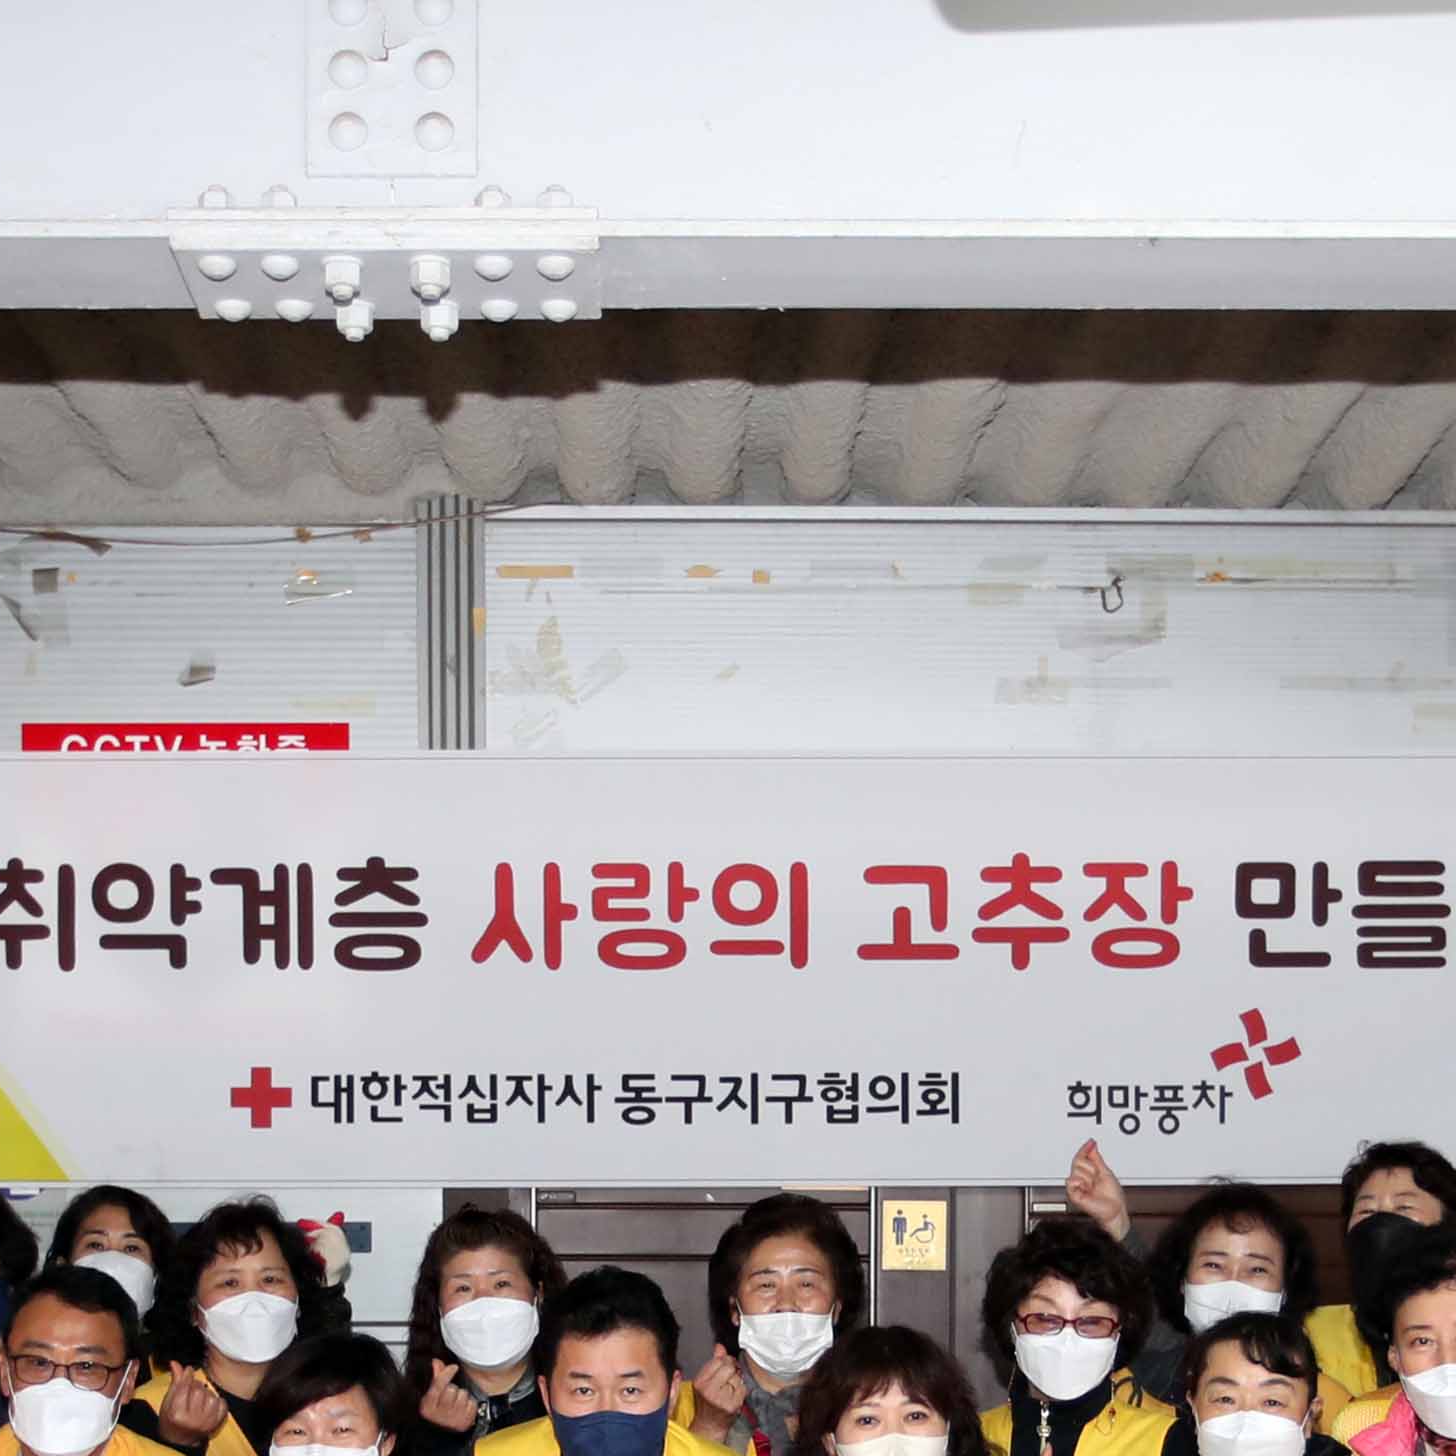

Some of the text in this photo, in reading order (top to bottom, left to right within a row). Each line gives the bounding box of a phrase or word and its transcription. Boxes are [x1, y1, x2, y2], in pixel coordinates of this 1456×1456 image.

[472, 863, 808, 969] 사랑의
[858, 854, 1192, 969] 고추장
[311, 1071, 959, 1125] 대한적십자사 동구지구협의회
[1067, 1080, 1234, 1135] 희망풍차
